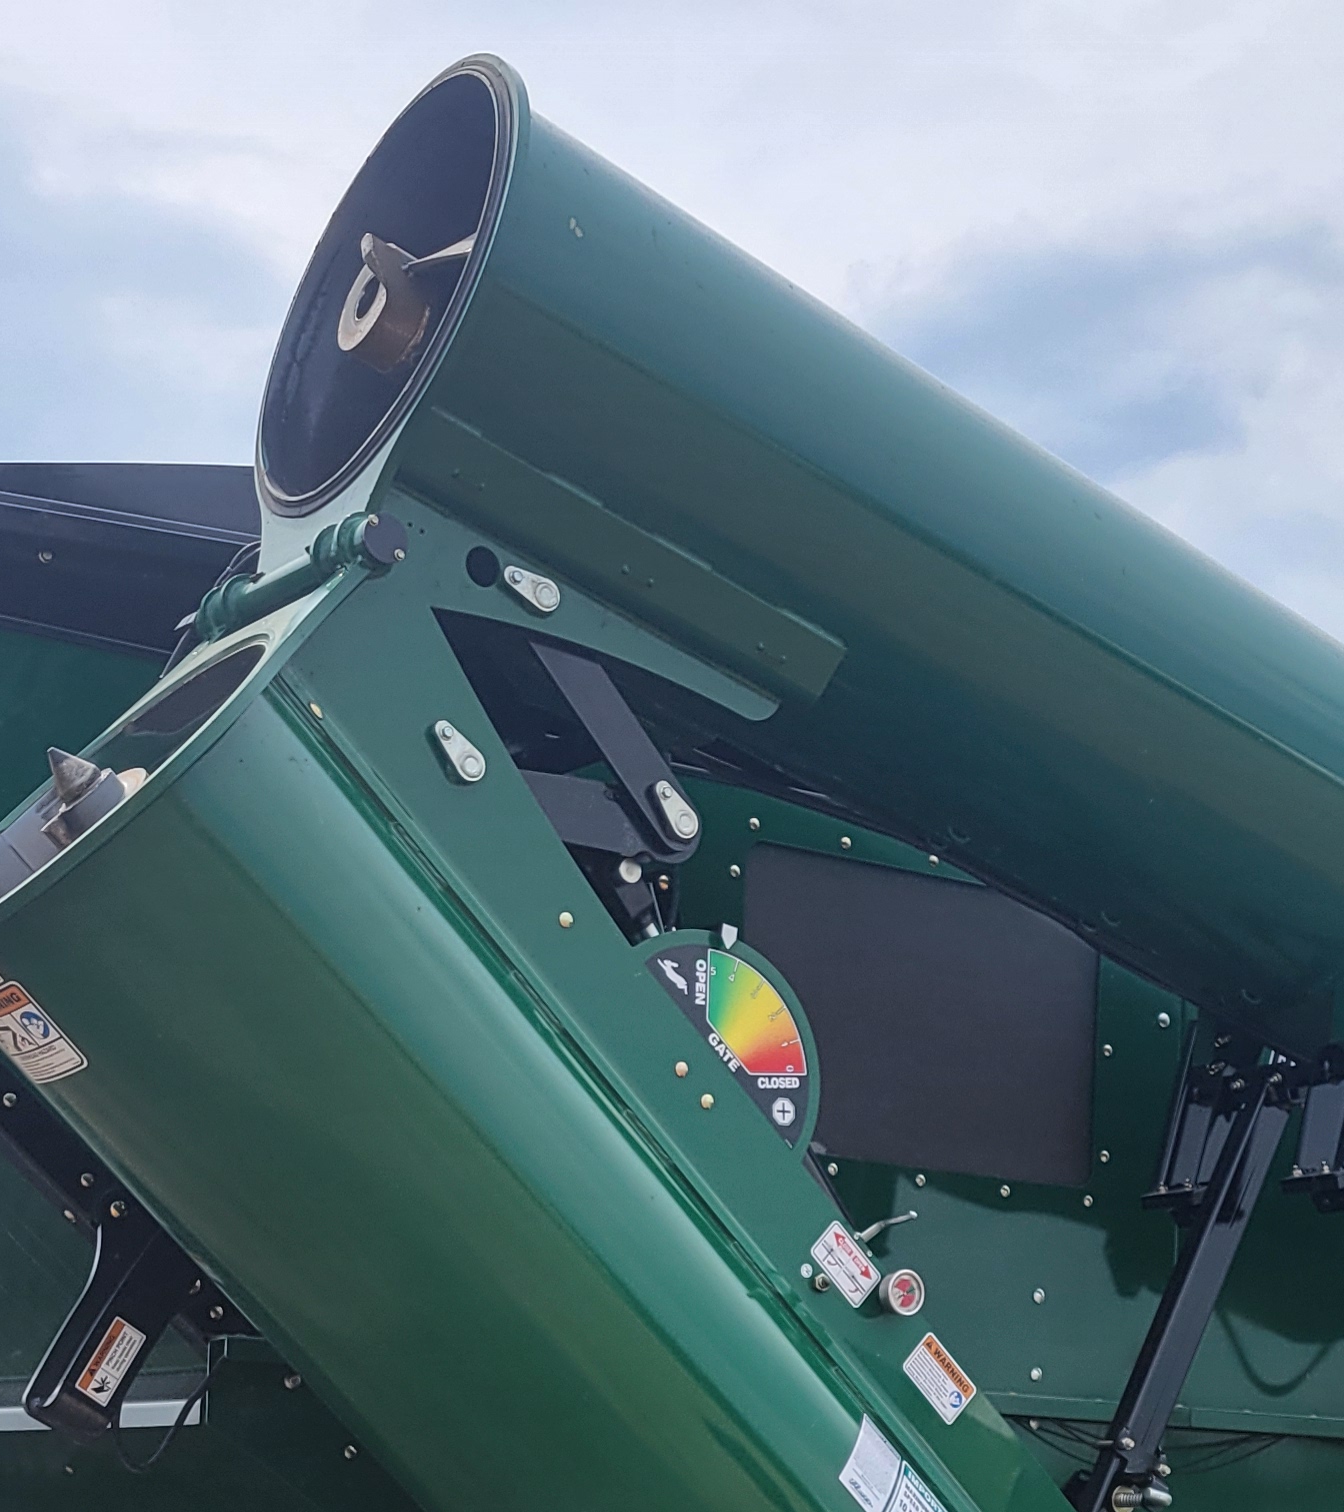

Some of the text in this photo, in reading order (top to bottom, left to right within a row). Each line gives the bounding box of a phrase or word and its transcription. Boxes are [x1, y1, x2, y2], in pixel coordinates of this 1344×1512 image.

[695, 959, 707, 1005] OPEN
[711, 967, 716, 975] 5
[708, 1032, 741, 1073] GATE
[758, 1077, 800, 1089] CLOSED
[933, 1348, 970, 1393] WARNING
[898, 1499, 908, 1511] 10
